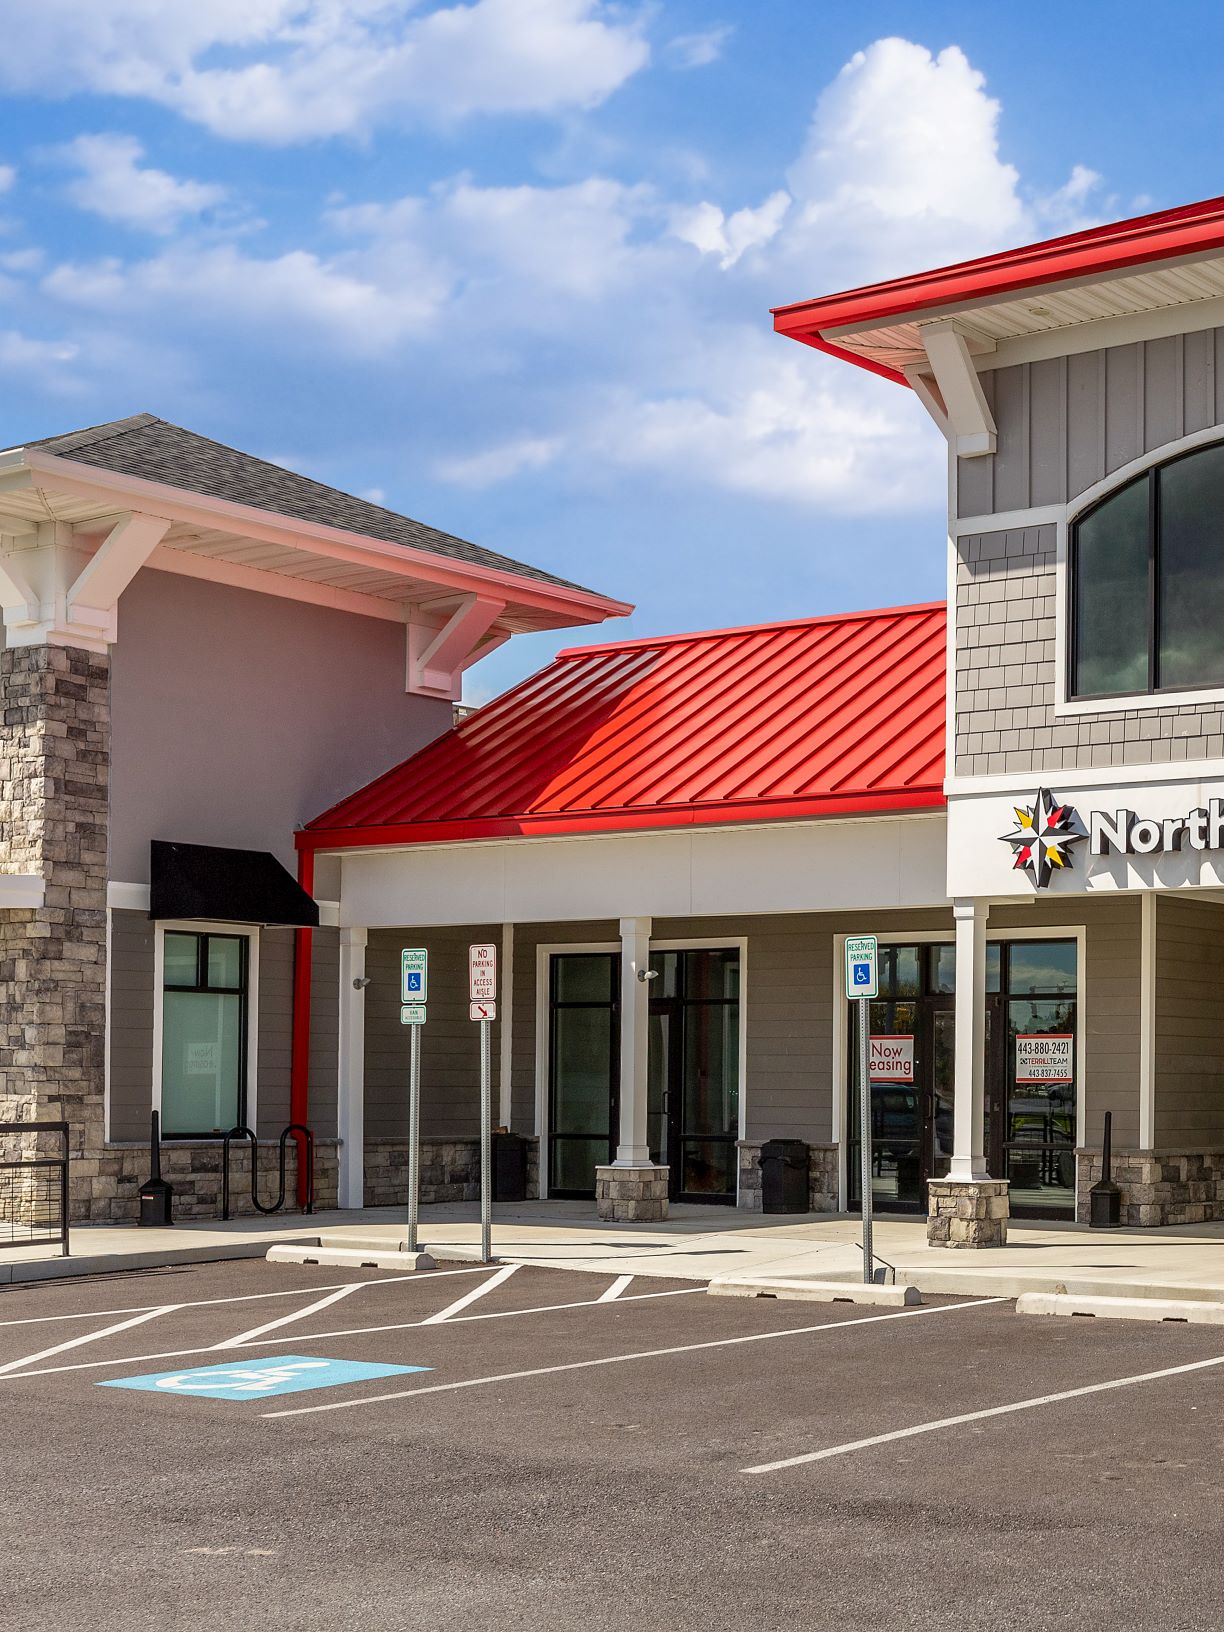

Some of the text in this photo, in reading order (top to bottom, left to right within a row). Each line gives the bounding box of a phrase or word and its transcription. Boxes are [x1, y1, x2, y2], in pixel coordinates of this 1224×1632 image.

[848, 943, 875, 951] RESERVED
[477, 949, 488, 958] NO
[850, 953, 873, 961] PARKING
[405, 963, 424, 971] PARKING
[472, 960, 493, 968] PARKING
[473, 979, 493, 987] ACCESS
[871, 1042, 904, 1058] Now
[1017, 1042, 1069, 1055] 443-880-2421
[869, 1057, 912, 1075] easing
[1028, 1069, 1068, 1078] 443-837-7455
